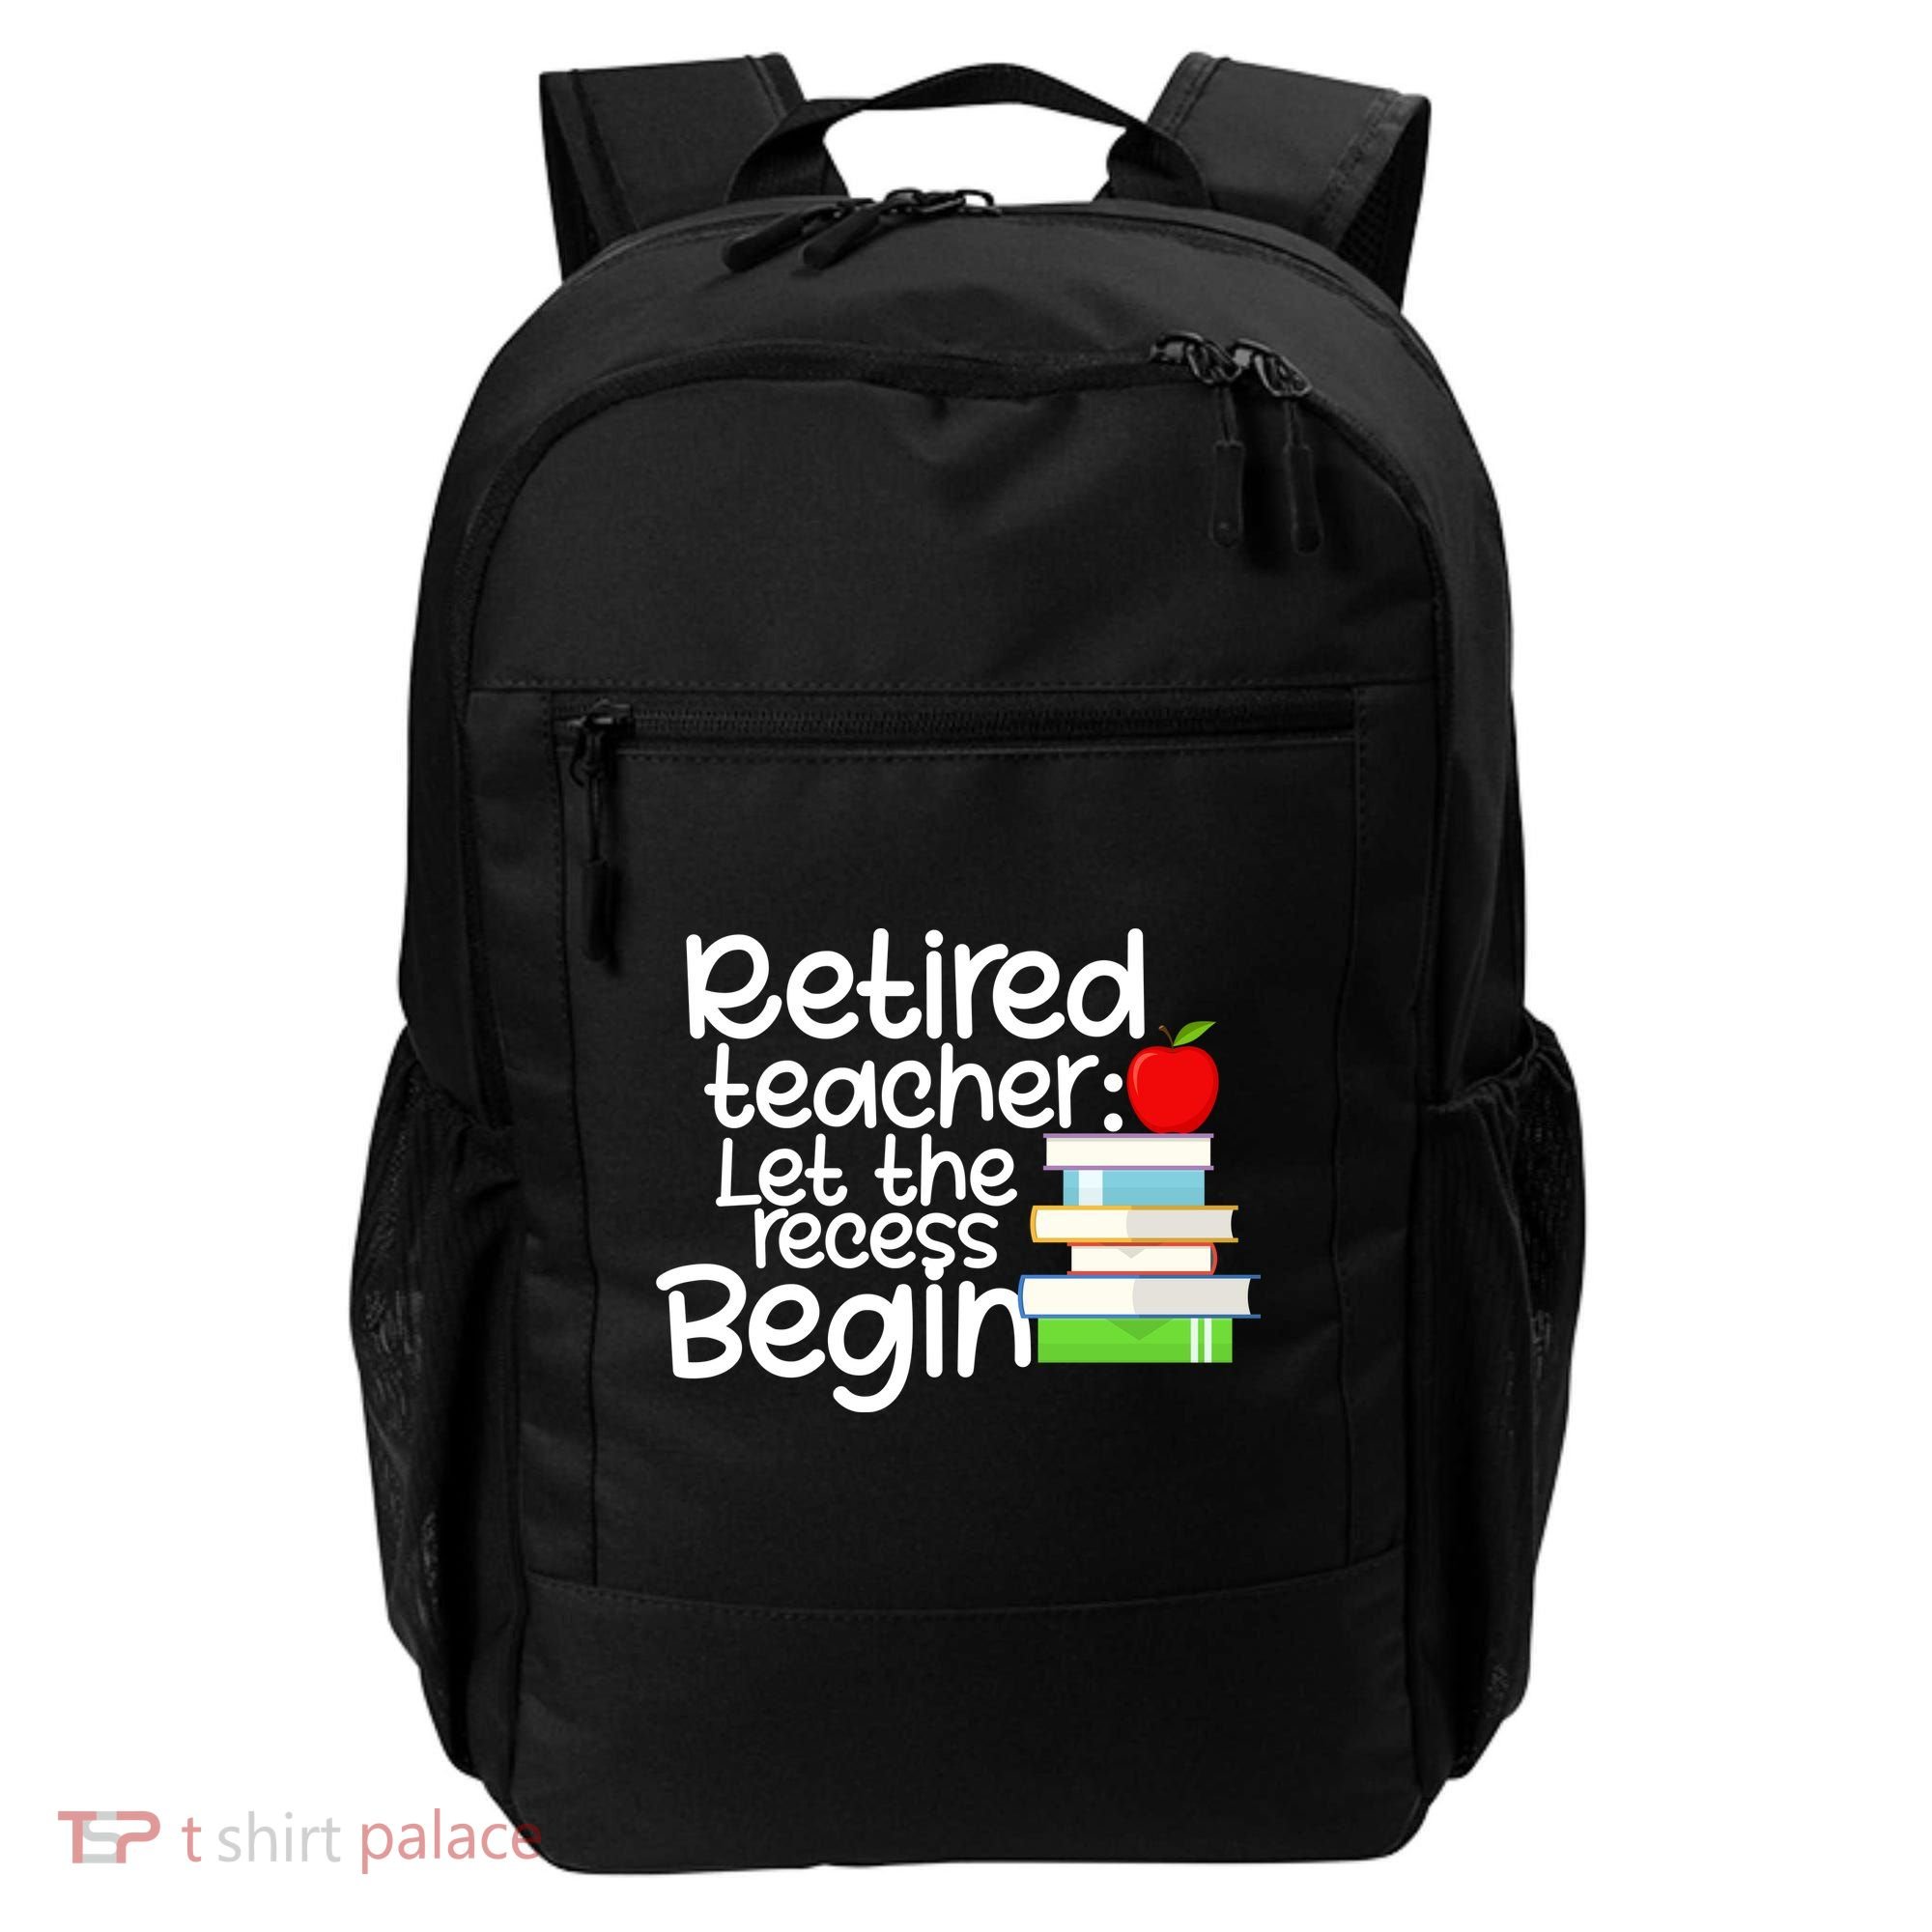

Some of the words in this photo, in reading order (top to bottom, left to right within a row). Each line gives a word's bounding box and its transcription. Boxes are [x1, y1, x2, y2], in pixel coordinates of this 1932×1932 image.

[685, 927, 1146, 1039] Retired
[703, 1042, 1123, 1132] teacher:
[715, 1133, 848, 1208] Let
[873, 1133, 1018, 1207] the
[753, 1208, 999, 1269] recess
[655, 1263, 1032, 1413] Begin
